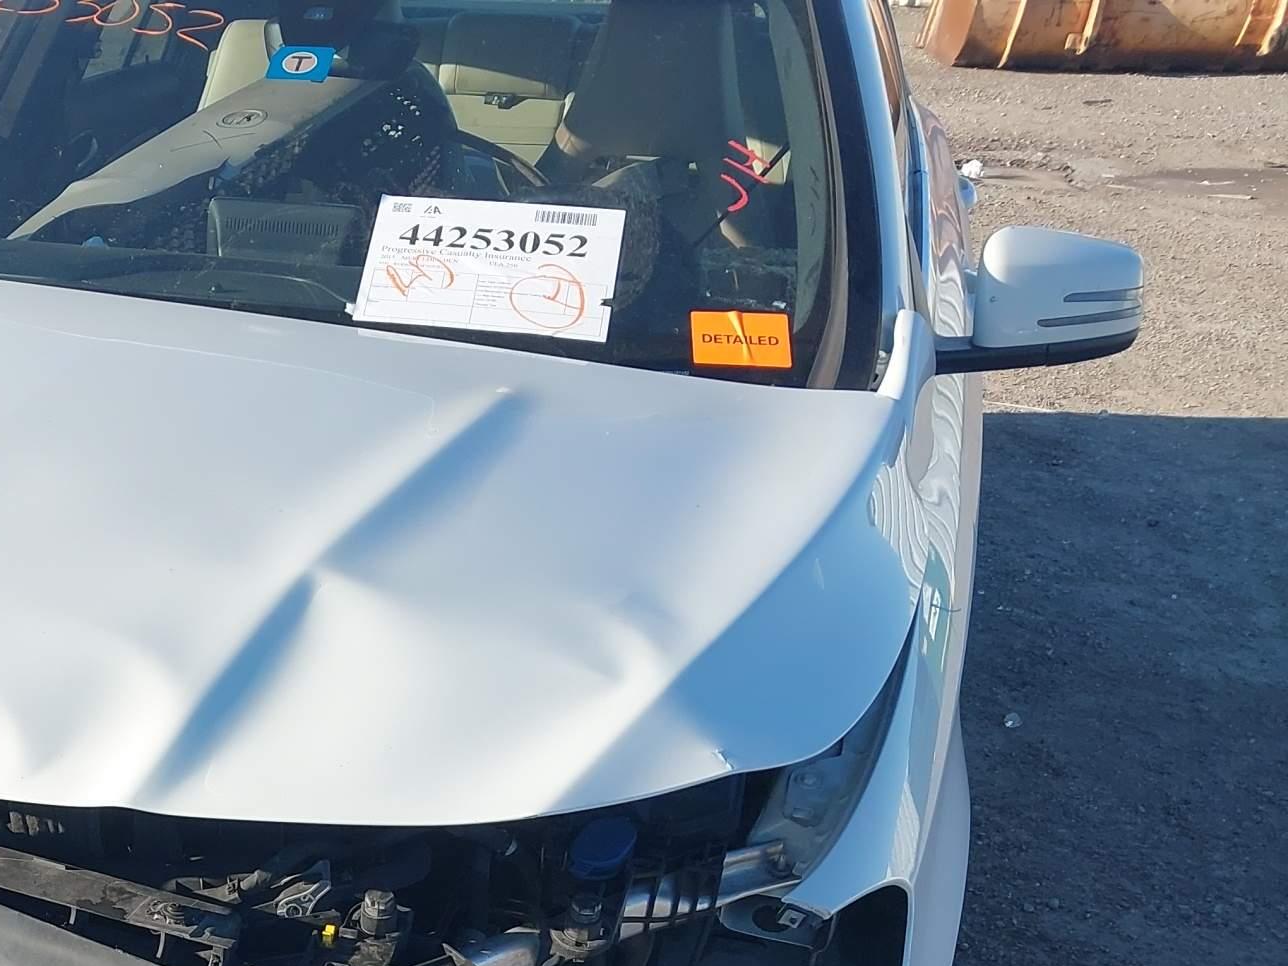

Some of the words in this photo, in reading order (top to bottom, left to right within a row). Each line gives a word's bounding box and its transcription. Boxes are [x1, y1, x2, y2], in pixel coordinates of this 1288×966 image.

[291, 55, 313, 72] T
[398, 223, 589, 258] 44253052
[381, 245, 435, 256] Progressive
[439, 249, 481, 260] Casualty
[484, 252, 532, 263] Insurance
[701, 333, 779, 346] DETAILED
